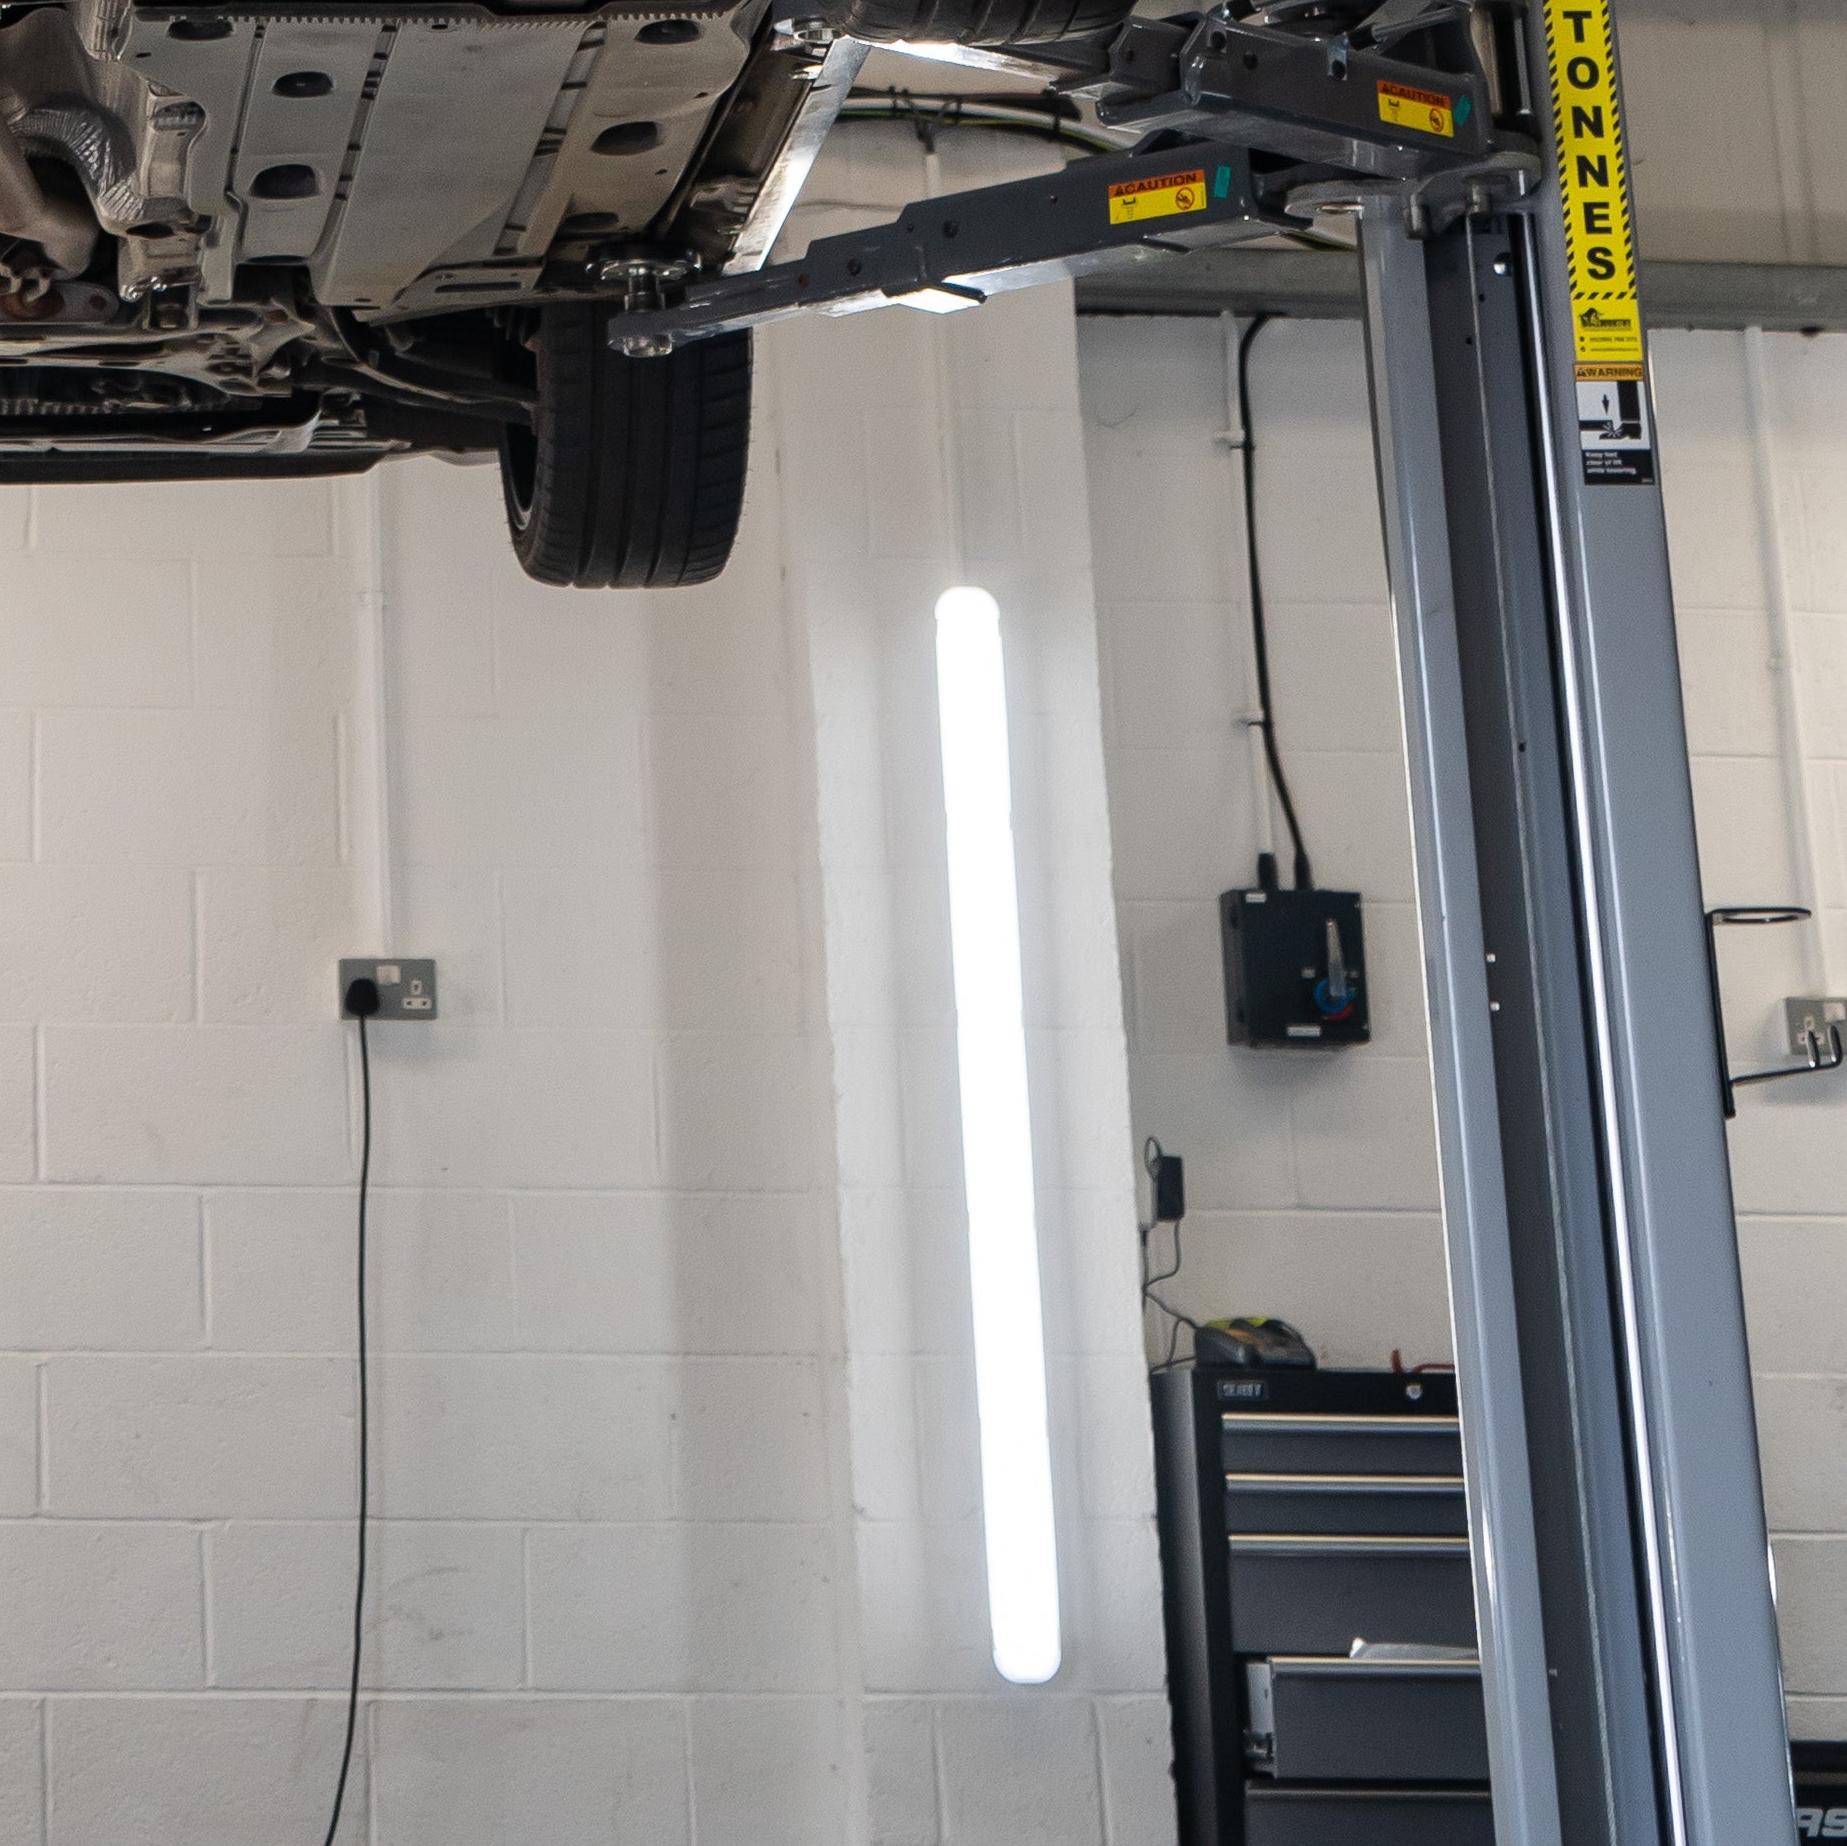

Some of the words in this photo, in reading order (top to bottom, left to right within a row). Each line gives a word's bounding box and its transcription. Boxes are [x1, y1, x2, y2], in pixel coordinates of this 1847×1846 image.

[1389, 85, 1445, 107] CAUTION
[1562, 10, 1616, 280] TONNES
[1125, 172, 1197, 195] CAUTION
[1586, 367, 1641, 378] WARNING
